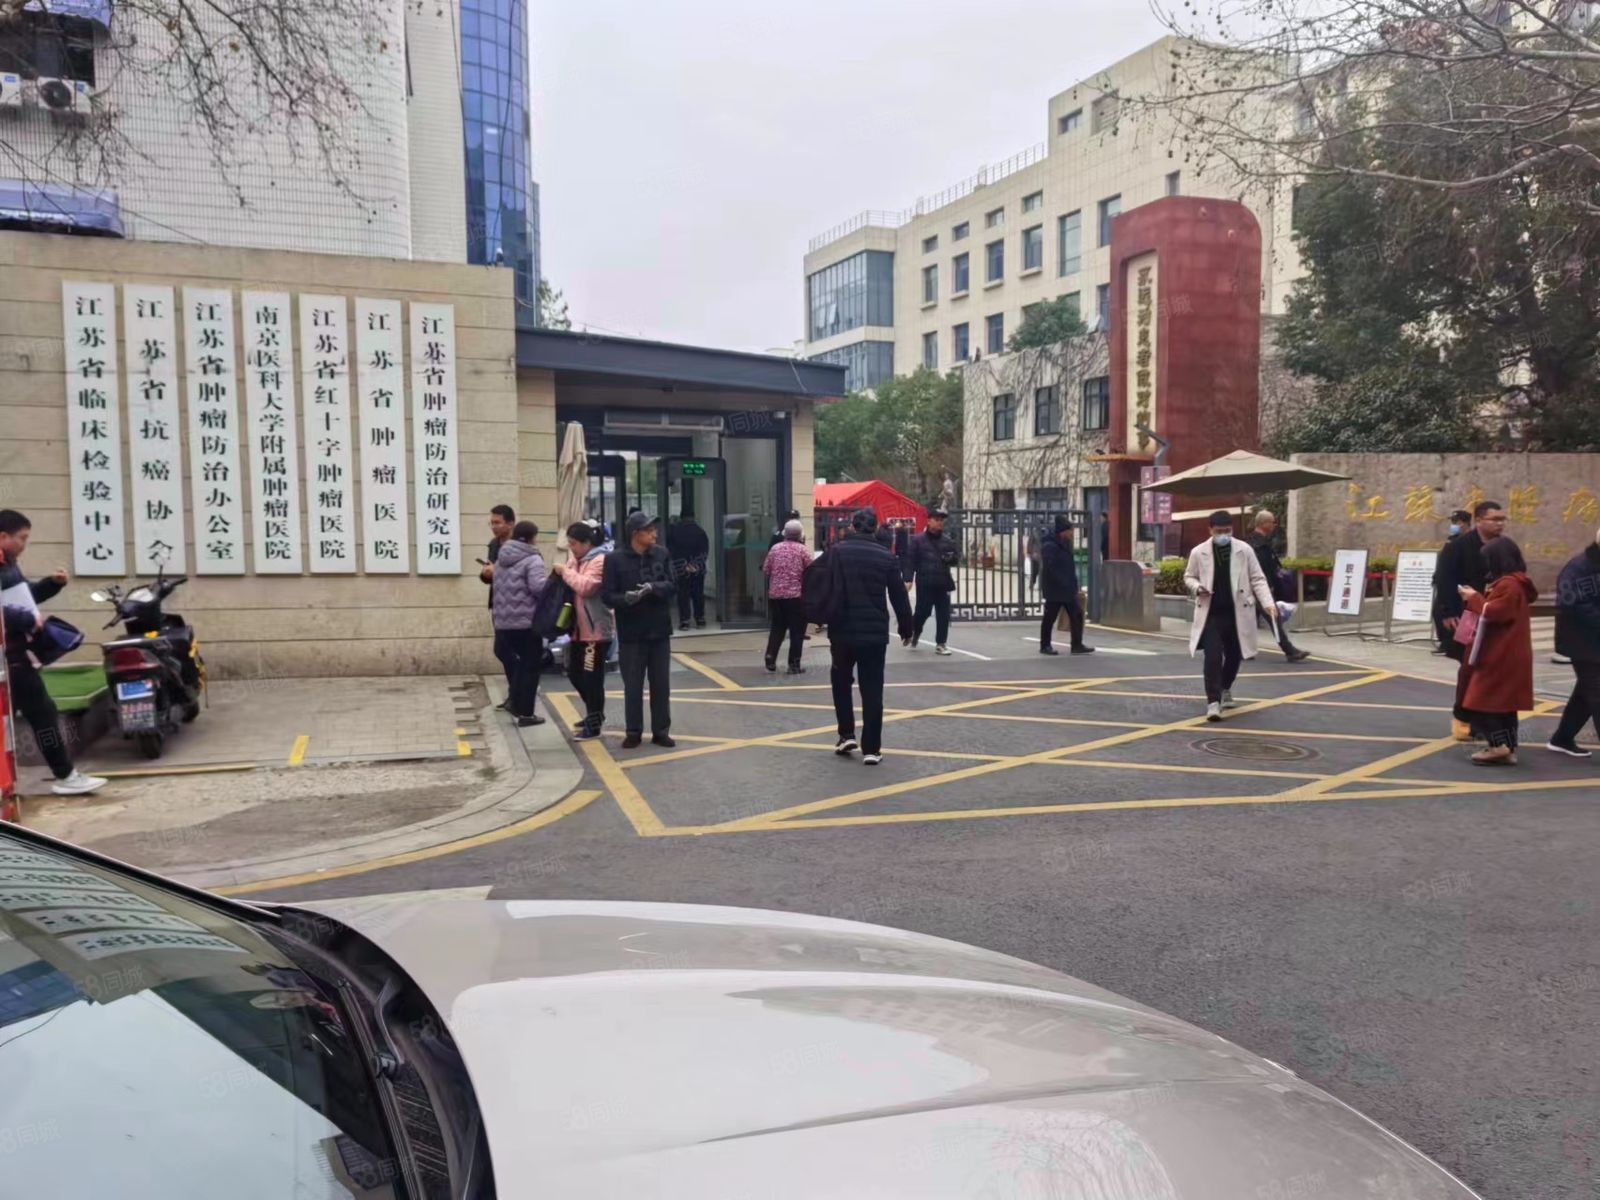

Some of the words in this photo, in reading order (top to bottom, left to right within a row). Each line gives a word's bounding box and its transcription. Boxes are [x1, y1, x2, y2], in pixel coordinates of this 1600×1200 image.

[76, 297, 114, 561] 江苏省临床检验中心
[137, 298, 173, 567] 江苏省抗癌协会
[196, 302, 234, 559] 江苏省肿瘤防治办公室
[256, 306, 291, 560] 南京医科大学附属肿瘤医院
[312, 309, 346, 559] 江苏省红十字肿瘤医院
[368, 312, 399, 559] 江苏省肿瘤医院
[422, 317, 451, 560] 江苏省肿瘤防治研究所
